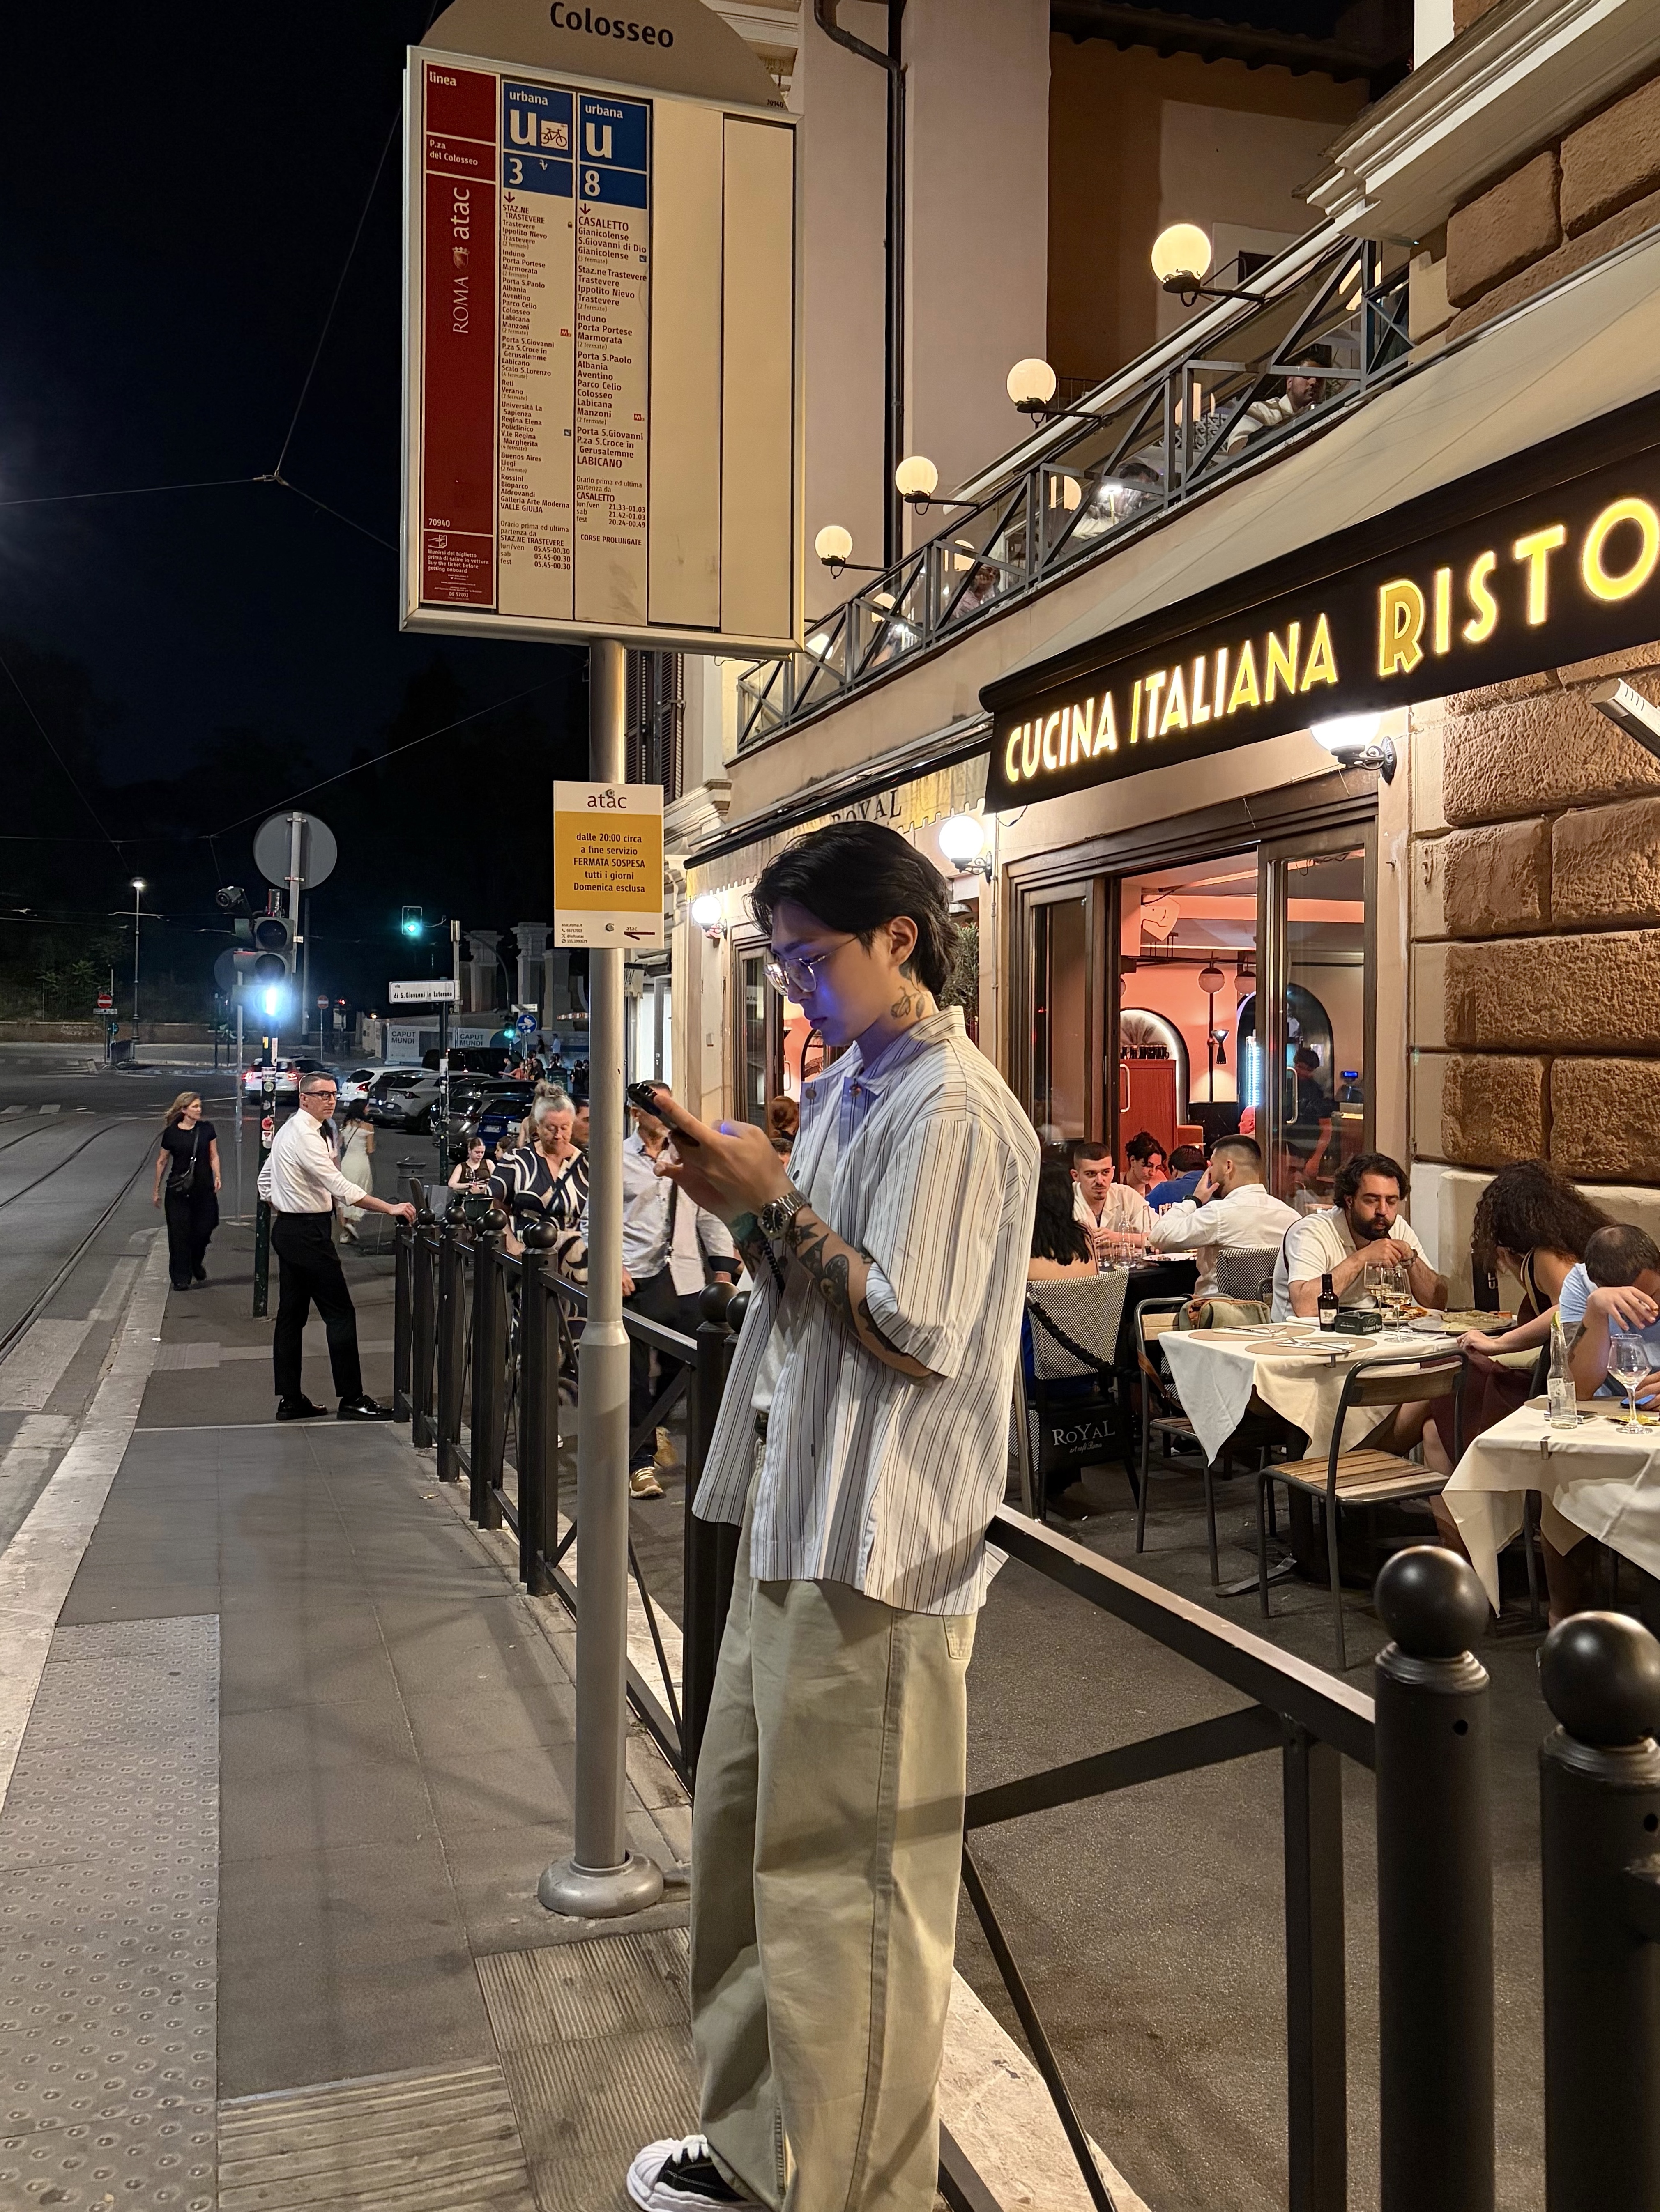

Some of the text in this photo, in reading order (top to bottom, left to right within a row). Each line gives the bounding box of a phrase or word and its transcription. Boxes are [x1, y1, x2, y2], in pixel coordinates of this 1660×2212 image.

[550, 2, 673, 48] Colosseo
[429, 71, 457, 86] linea
[509, 91, 548, 106] urbana
[585, 104, 623, 119] urbana
[510, 109, 537, 146] u
[430, 139, 446, 149] P.za
[586, 122, 612, 159] u
[430, 151, 478, 165] del Colosseo
[509, 158, 523, 184] 3
[584, 170, 600, 196] 8
[450, 187, 470, 240] atac
[506, 212, 545, 224] TRASTEVERE
[503, 220, 535, 230] Trastevere
[578, 216, 629, 231] CASALETTO
[503, 234, 535, 244] Trastevere
[578, 227, 629, 241] Gianicolense
[578, 237, 620, 249] S.Giovanni
[633, 244, 646, 253] Dio
[503, 249, 525, 258] Induno
[578, 246, 629, 260] Gianicolense
[522, 259, 546, 268] Portese
[503, 264, 537, 274] Marmorata
[578, 265, 647, 281] Staz.ne Trastevere
[522, 280, 545, 288] S.Paolo
[578, 275, 619, 287] Trastevere
[503, 285, 526, 293] Albania
[578, 285, 635, 298] Ippolito Nievo
[503, 292, 530, 301] Aventino
[578, 294, 619, 306] Trastevere
[453, 276, 468, 333] ROMA
[502, 306, 530, 315] Colosseo
[502, 314, 530, 322] Labicana
[578, 313, 606, 323] Induno
[502, 321, 529, 330] Manzoni
[578, 323, 632, 336] Porta Portese
[522, 338, 554, 348] S.Giovanni
[578, 332, 622, 344] Marmorata
[517, 345, 539, 353] S.Croce
[504, 351, 547, 361] Gerusalemme
[578, 351, 631, 364] Porta S.Paolo
[502, 358, 530, 366] Labicano
[578, 361, 608, 370] Albania
[521, 367, 551, 376] S.Lorenzo
[578, 370, 613, 380] Aventino
[578, 379, 622, 391] Parco Celio
[577, 389, 612, 399] Colosseo
[502, 401, 533, 410] Università
[577, 398, 612, 408] Labicana
[577, 407, 611, 418] Manzoni
[502, 416, 523, 424] Regina
[502, 423, 533, 432] Policlinico
[577, 426, 643, 440] Porta S.Giovanni
[503, 438, 538, 447] Margherita
[596, 438, 624, 447] S.Croce
[580, 446, 633, 458] Gerusalemme
[577, 455, 622, 468] LABICANO
[501, 481, 528, 490] Bioparco
[501, 489, 535, 497] Aldrovandi
[577, 492, 615, 502] CASALETTO
[522, 505, 543, 513] GIULIA
[542, 500, 569, 508] Moderna
[609, 504, 645, 513] 21.33-01.03
[609, 511, 645, 520] 21.42-01.03
[428, 518, 450, 527] 70940
[608, 519, 645, 528] 20.24-00.49
[527, 537, 564, 547] TRASTEVERE
[602, 536, 642, 545] PROLUNGATE
[534, 546, 570, 554] 05.45-00.30
[534, 554, 570, 562] 05.45-00.30
[534, 561, 570, 570] 05.45-00.30
[1377, 495, 1660, 678] RISTO
[1004, 611, 1340, 784] CUCINA ITALIANA
[587, 793, 627, 809] atac
[576, 832, 642, 843] dalle 20:00 circa
[588, 846, 604, 854] fine
[607, 847, 638, 855] servizio
[574, 858, 645, 868] FERMATA SOSPESA
[610, 872, 634, 881] giorni
[574, 883, 645, 892] Domenica esclusa
